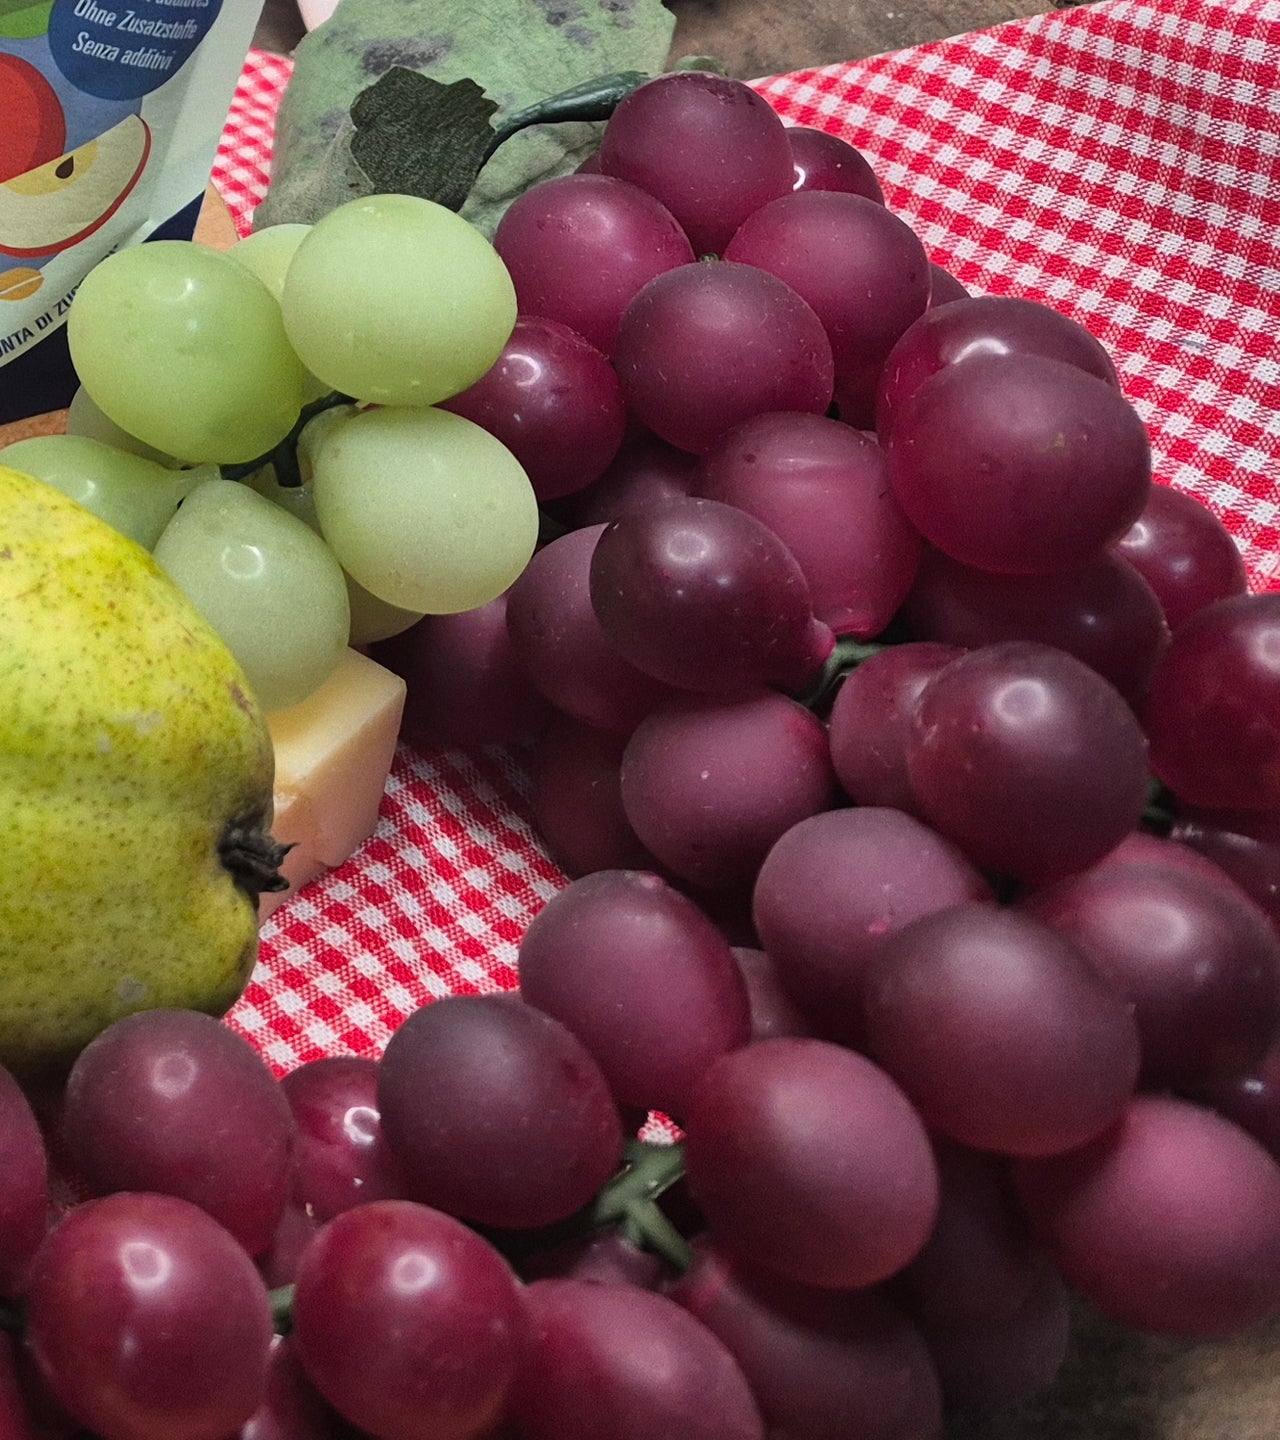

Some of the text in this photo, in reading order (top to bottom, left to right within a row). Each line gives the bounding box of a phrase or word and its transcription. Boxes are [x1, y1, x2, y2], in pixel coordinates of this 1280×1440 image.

[116, 9, 198, 39] Zusatzstoffe
[71, 31, 177, 71] Senza additivi
[34, 312, 54, 330] DI
